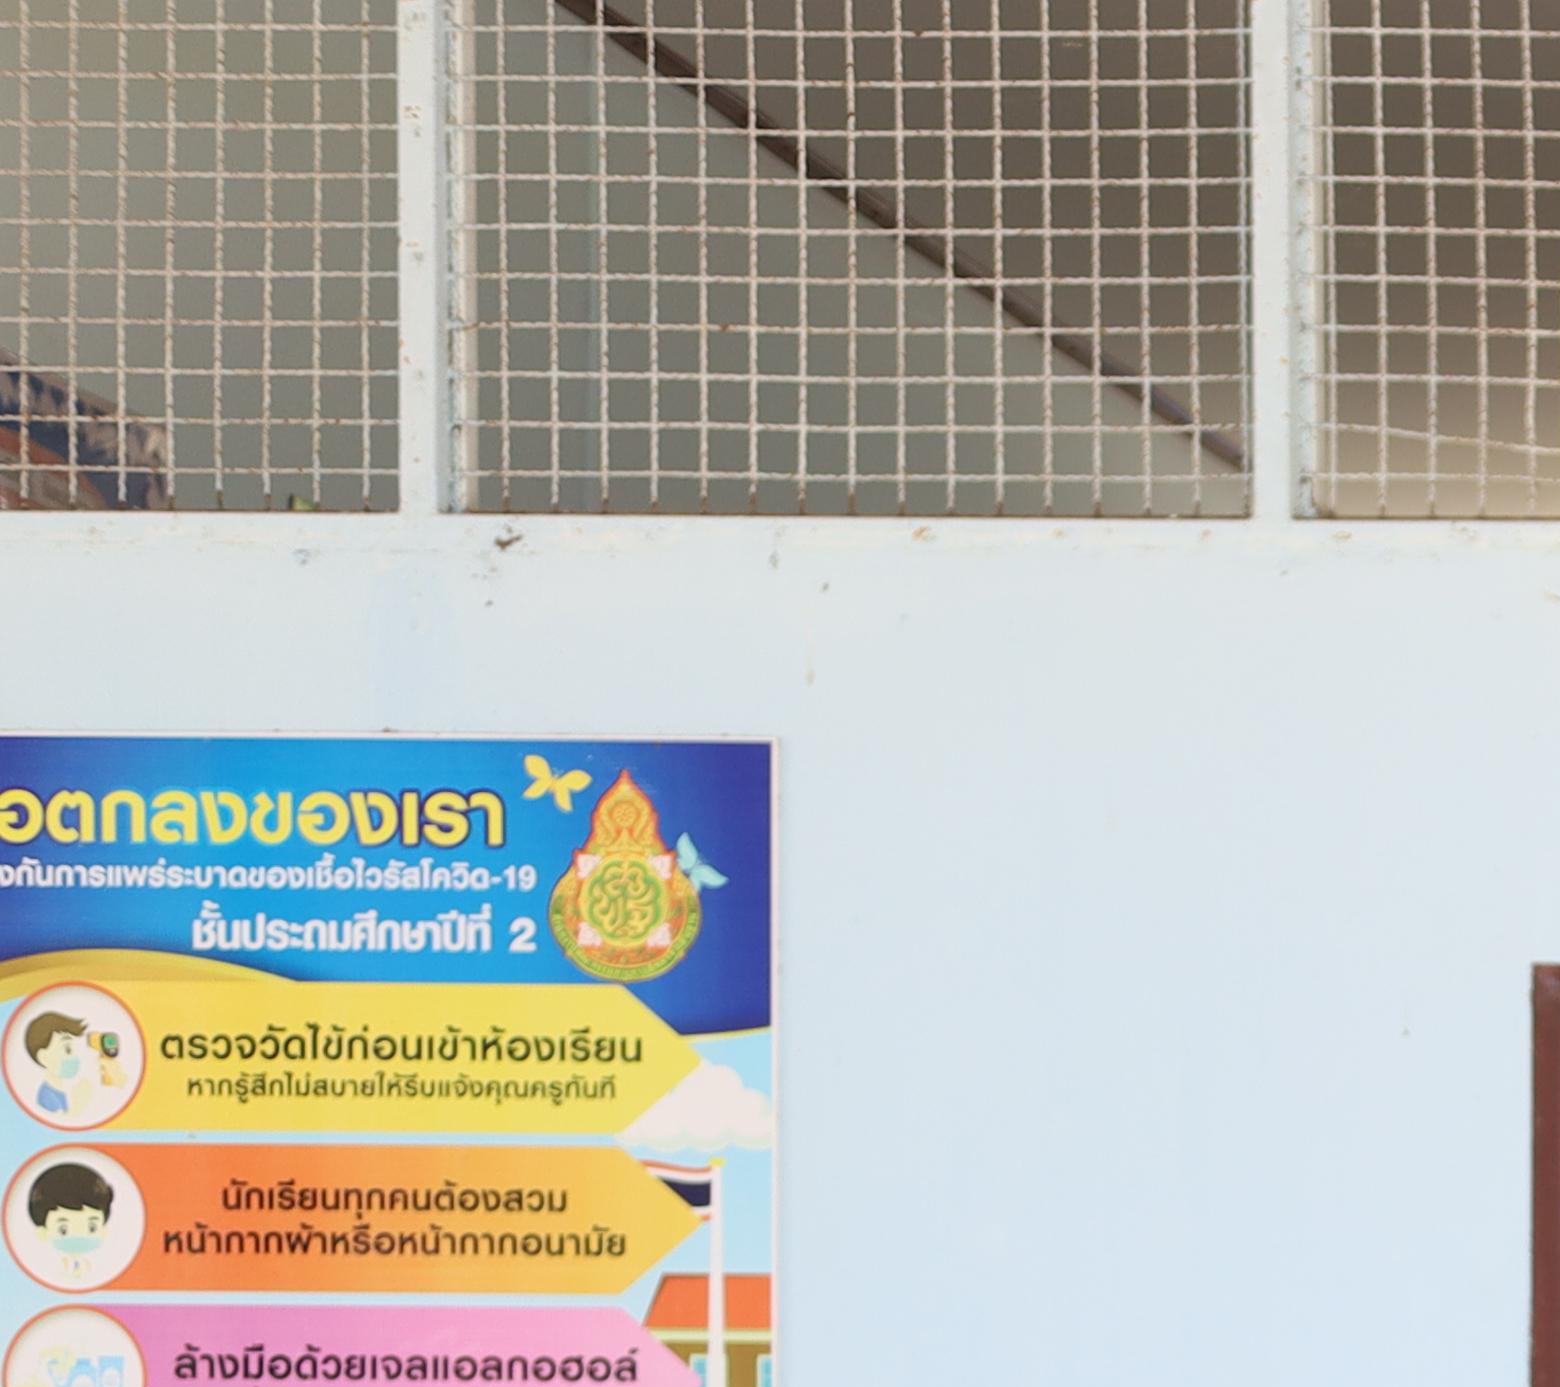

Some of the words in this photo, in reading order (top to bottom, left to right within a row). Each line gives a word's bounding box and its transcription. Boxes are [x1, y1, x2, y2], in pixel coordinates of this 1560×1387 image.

[191, 899, 493, 951] ชั้นประถมศึกษาปีที่
[508, 916, 538, 951] 2
[160, 1021, 643, 1063] ตรวจวัดไข้ก่อนเข้าห้องเรียน
[186, 1070, 617, 1106] หากรู้สึกไม่สบายให้รีบแจ้งคุณครูทันที
[221, 1178, 568, 1221] นักเรียนทุกคนต้องสวม
[163, 1221, 627, 1258] หน้ากากผ้าหรือหน้ากากอนามัย
[174, 1342, 639, 1382] ล้างมือด้วยเจลแอลกอฮอล์
